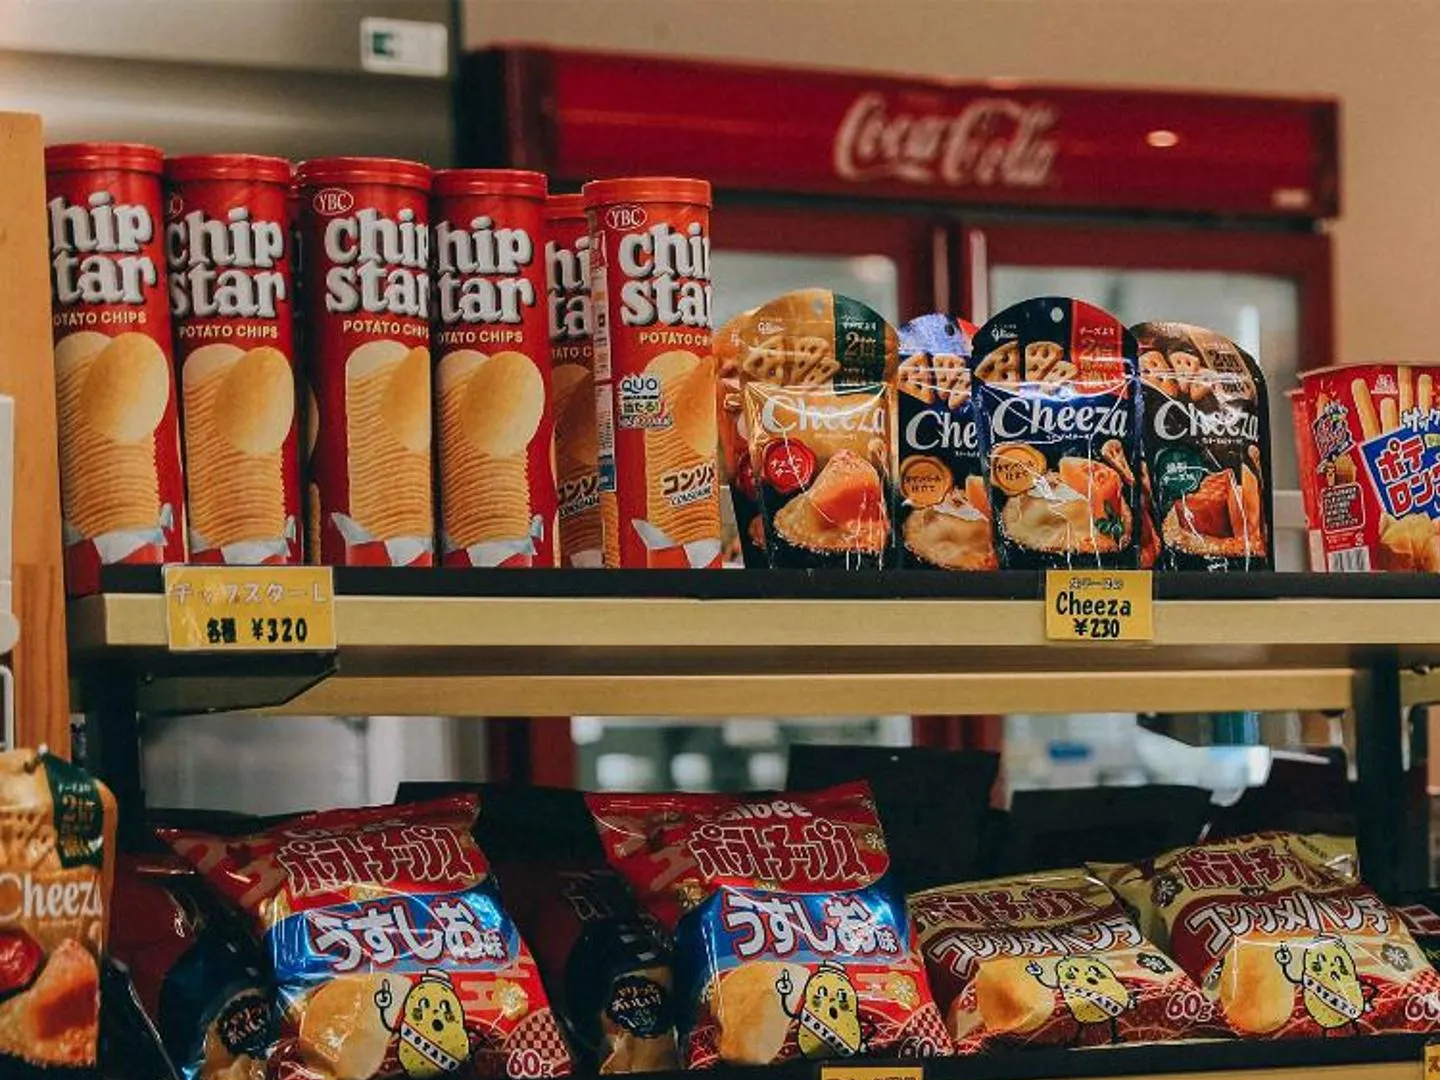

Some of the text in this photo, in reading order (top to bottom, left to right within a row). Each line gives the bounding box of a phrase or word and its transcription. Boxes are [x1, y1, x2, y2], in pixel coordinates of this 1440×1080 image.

[318, 193, 348, 210] YBC
[611, 210, 642, 226] YBC
[48, 191, 153, 252] hip
[167, 206, 284, 268] chip
[436, 215, 533, 275] hip
[53, 250, 156, 304] tar
[545, 235, 593, 292] hi
[169, 263, 286, 318] star
[438, 271, 535, 324] tar
[100, 310, 147, 324] CHIPS
[342, 319, 401, 334] POTATO
[547, 290, 594, 338] ta
[179, 325, 279, 340] POTATO CHIPS
[439, 331, 523, 344] TATO CHIPS
[621, 377, 659, 394] QUO
[761, 394, 886, 434] Cheeza
[905, 409, 978, 451] Che
[992, 396, 1129, 440] Cheeza
[1056, 590, 1132, 617] Cheeza
[251, 617, 308, 643] ¥320
[1072, 617, 1121, 638] ¥230
[1165, 991, 1214, 1023] 60g
